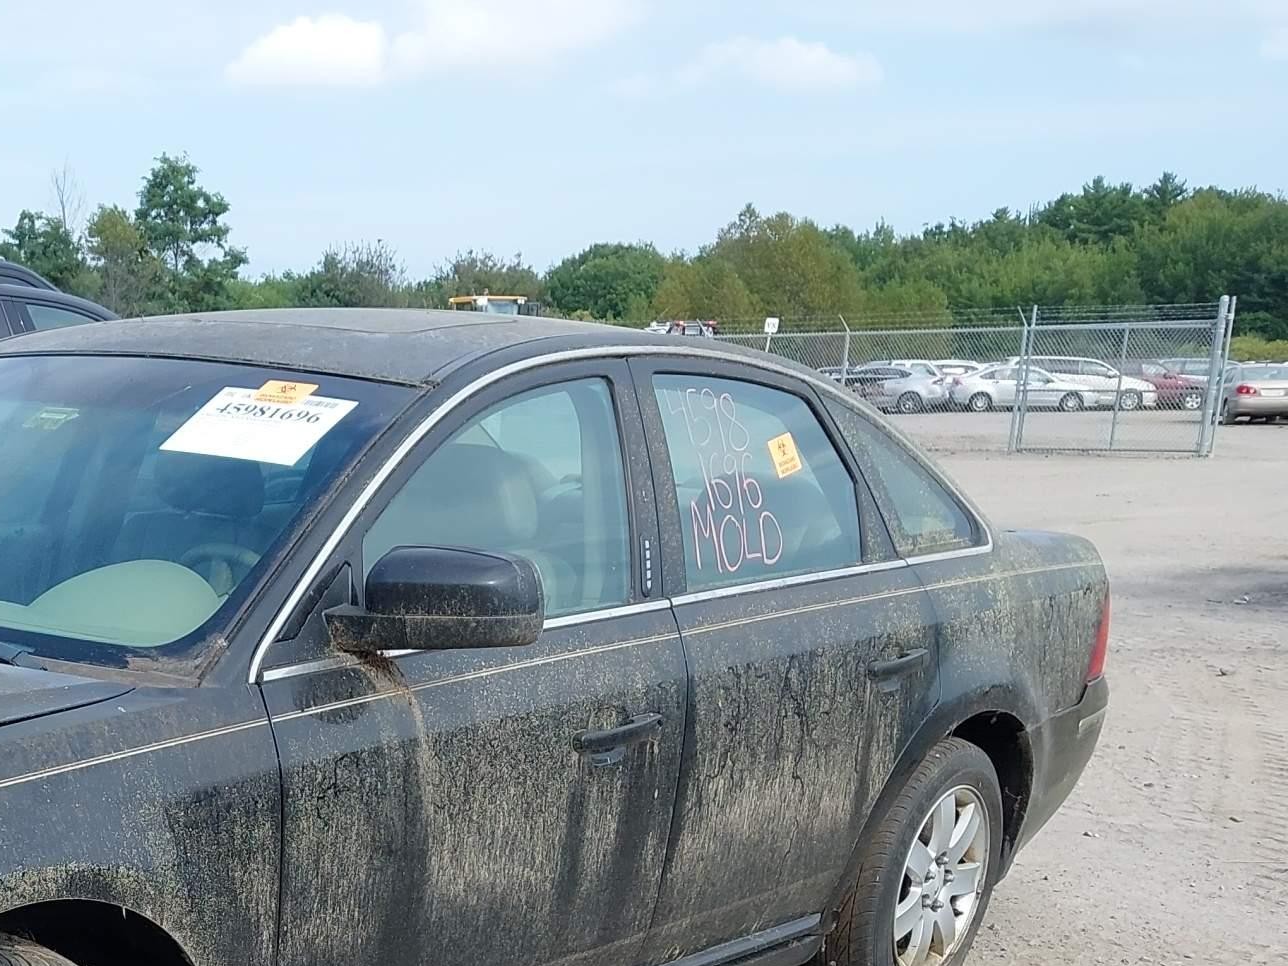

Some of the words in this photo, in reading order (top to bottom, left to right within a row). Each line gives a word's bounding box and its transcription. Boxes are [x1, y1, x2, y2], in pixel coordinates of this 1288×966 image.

[217, 402, 320, 424] 45981696
[663, 388, 750, 452] 4598
[697, 452, 763, 515] 1696
[690, 499, 783, 573] MOLD
